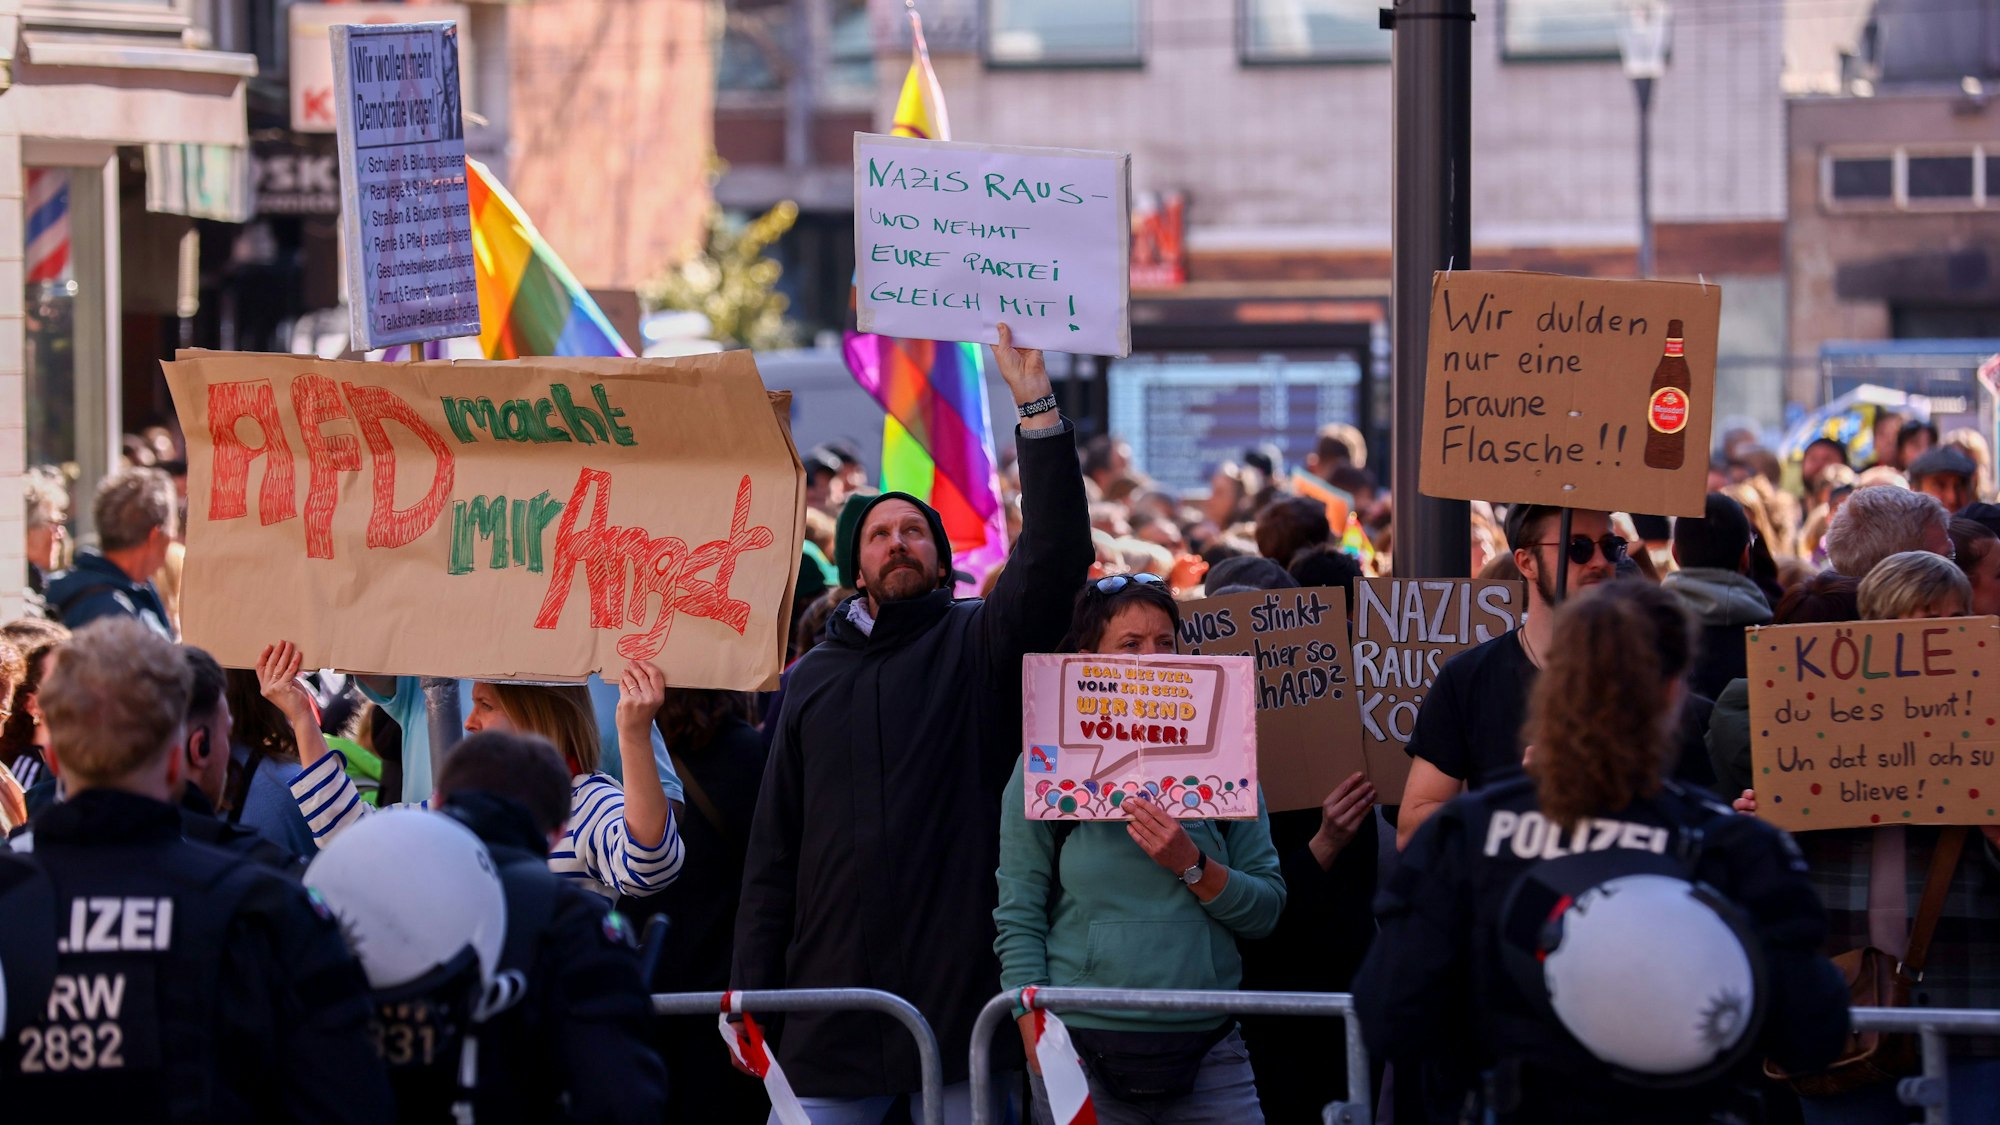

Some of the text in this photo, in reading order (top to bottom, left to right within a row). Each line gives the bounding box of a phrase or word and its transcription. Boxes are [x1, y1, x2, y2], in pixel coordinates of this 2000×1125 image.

[354, 43, 432, 83] Wir wollen mehr
[357, 89, 436, 135] Demokratie wagen!
[368, 153, 465, 173] Schulen & Bildung sanieren
[372, 201, 470, 227] Straßen & Brücken sanieren
[869, 208, 1031, 240] UND NEHMT
[374, 235, 397, 253] Rente
[399, 234, 405, 250] &
[871, 244, 951, 268] EURE
[377, 257, 437, 279] Gesundheitswesen
[378, 287, 398, 305] Armut
[1443, 289, 1648, 336] Wir dulden
[1443, 343, 1583, 374] nur eine
[440, 383, 639, 447] macht
[1445, 381, 1547, 419] braune
[534, 466, 774, 660] Angst
[1250, 592, 1332, 633] stinkt
[1358, 579, 1515, 645] NAZIS
[1254, 638, 1338, 672] hier so
[1353, 640, 1443, 689] RAUS
[1796, 628, 1956, 682] KÖLLE
[1077, 680, 1193, 699] VOLK IHR SEID,
[1082, 665, 1193, 683] EGAL WIE VIEL
[1077, 696, 1196, 721] WIR SIND
[1356, 690, 1422, 743] KÖ
[1775, 689, 1973, 724] du bes bunt!
[1080, 715, 1188, 745] VÖLKER!
[1777, 746, 1815, 772] Un
[1829, 744, 1867, 769] dat
[1878, 741, 1916, 768] sull
[1929, 742, 1963, 767] och
[1483, 810, 1669, 860] POLIZEI
[58, 897, 173, 953] IZEI
[47, 973, 126, 1021] RW
[18, 1023, 125, 1073] 2832
